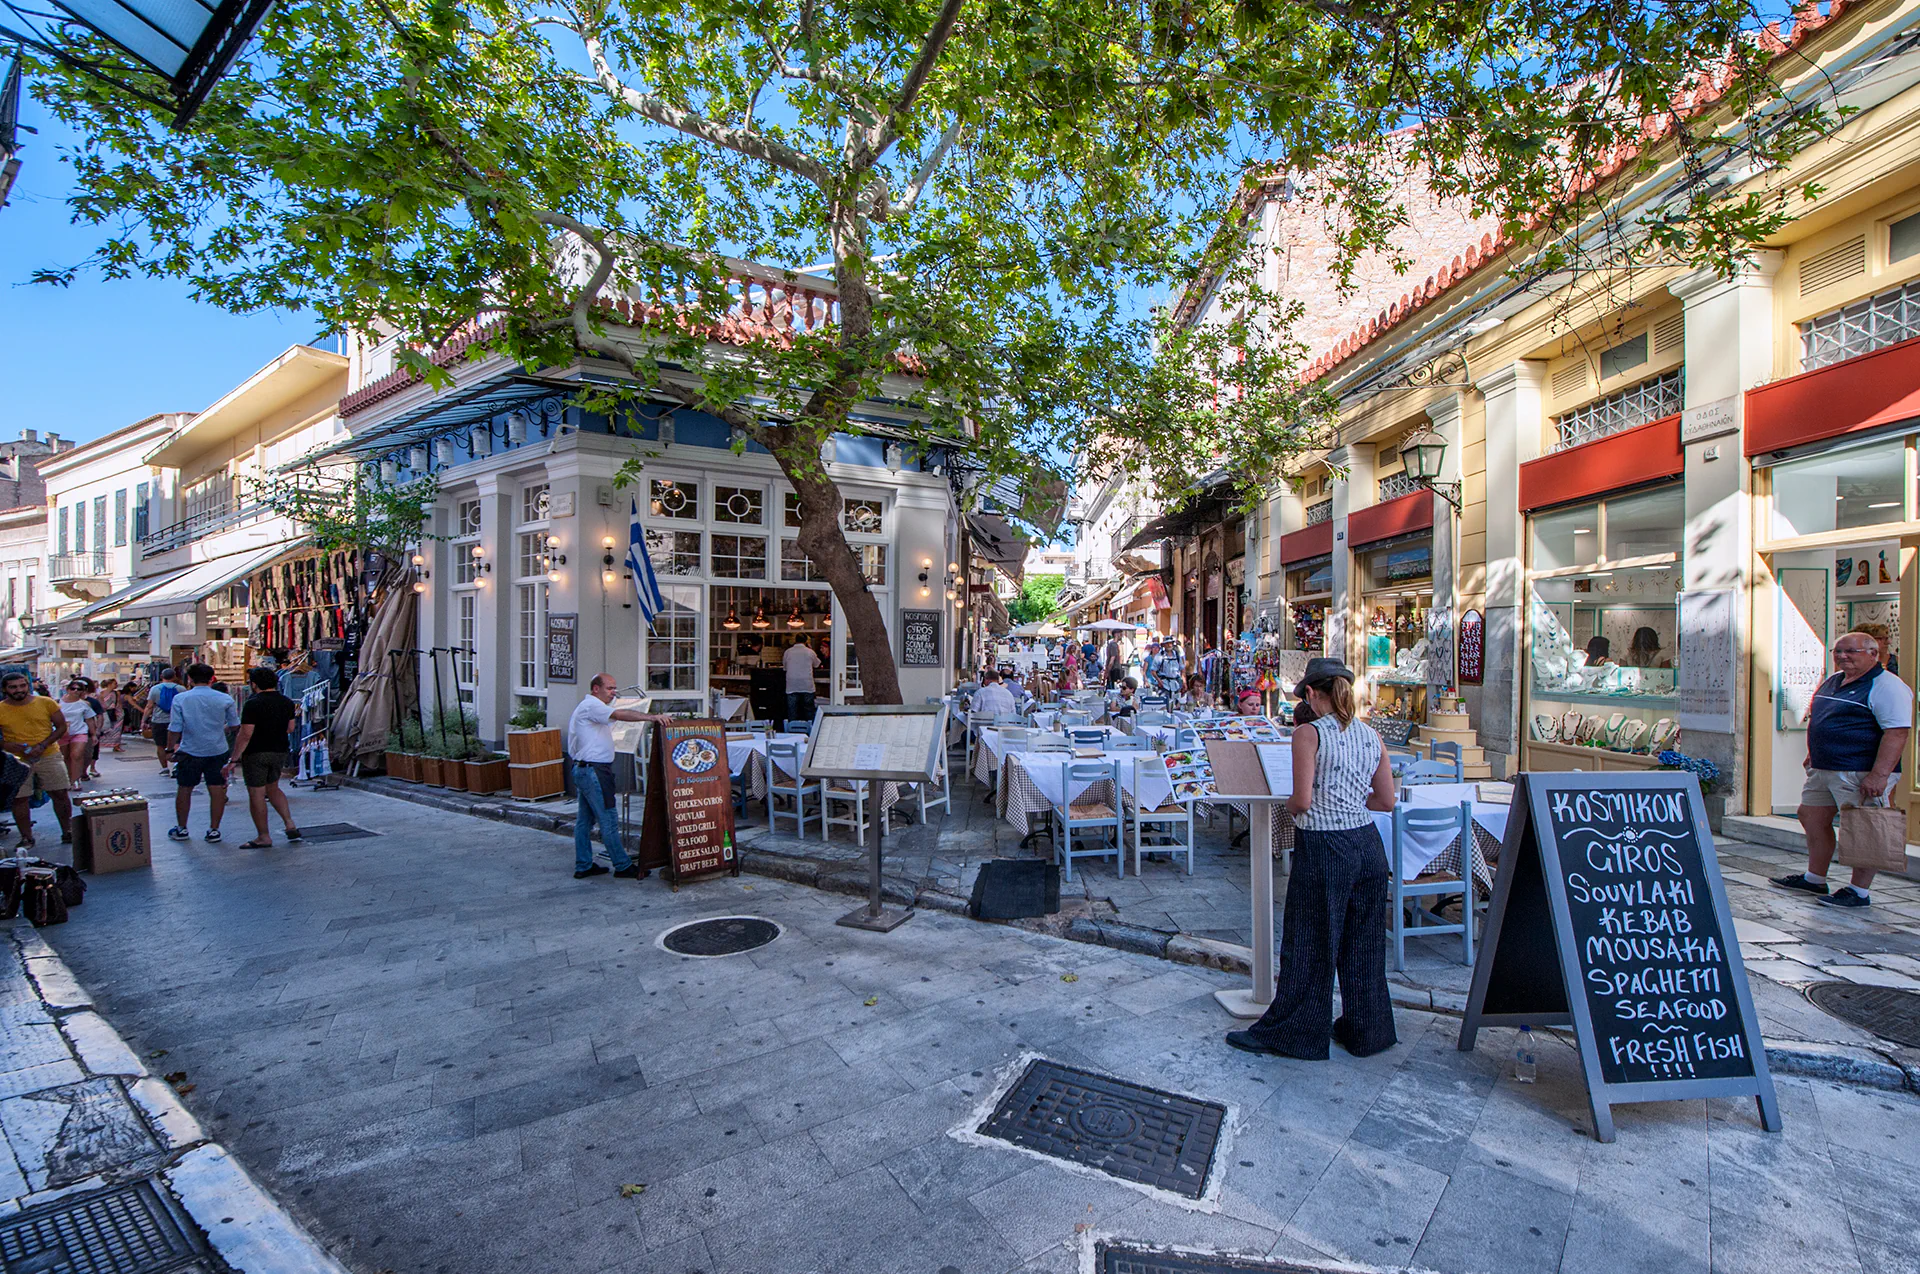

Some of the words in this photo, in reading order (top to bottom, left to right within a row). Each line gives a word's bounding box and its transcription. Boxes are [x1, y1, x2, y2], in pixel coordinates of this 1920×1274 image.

[1696, 407, 1719, 420] ΟΔΟΣ
[673, 787, 694, 797] GYROS
[674, 799, 702, 809] CHICKEN
[703, 796, 723, 806] GYROS
[675, 811, 706, 822] SOUVLAKI
[1552, 790, 1685, 823] KOSMIKON
[133, 822, 144, 855] CATERING
[676, 824, 698, 835] MIXED
[699, 821, 717, 831] GRILL
[679, 848, 700, 860] GREEK
[701, 845, 720, 855] SALAD
[1586, 840, 1683, 876] GYROS
[680, 862, 701, 873] DRAFT
[702, 858, 718, 868] BEER
[1568, 872, 1695, 906] SOUVLAKI
[1598, 907, 1693, 937] KEBAB
[1586, 936, 1722, 965] MOUSAKA
[1587, 967, 1721, 996] SPAGHETTI
[1615, 998, 1727, 1020] SEAFOOD
[1609, 1036, 1690, 1065] FRESH
[1693, 1032, 1744, 1061] FISH
